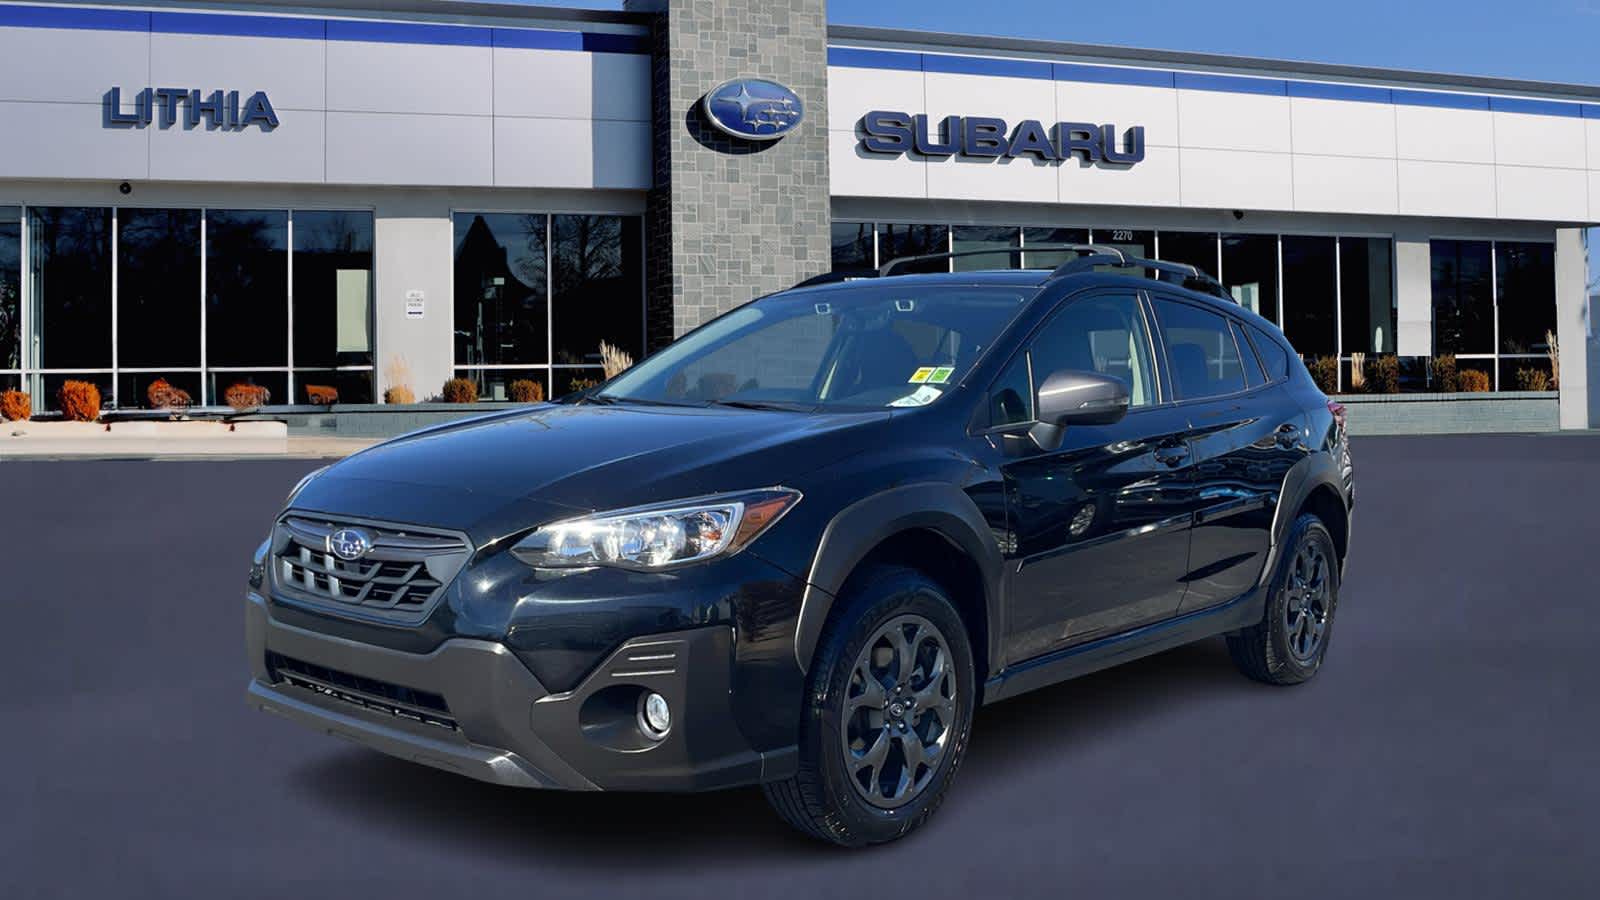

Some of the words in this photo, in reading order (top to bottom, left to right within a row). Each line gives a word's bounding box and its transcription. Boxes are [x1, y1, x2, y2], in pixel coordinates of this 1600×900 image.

[109, 86, 280, 127] LITHIA
[862, 110, 1145, 164] SUBARU
[1112, 230, 1133, 241] 2270
